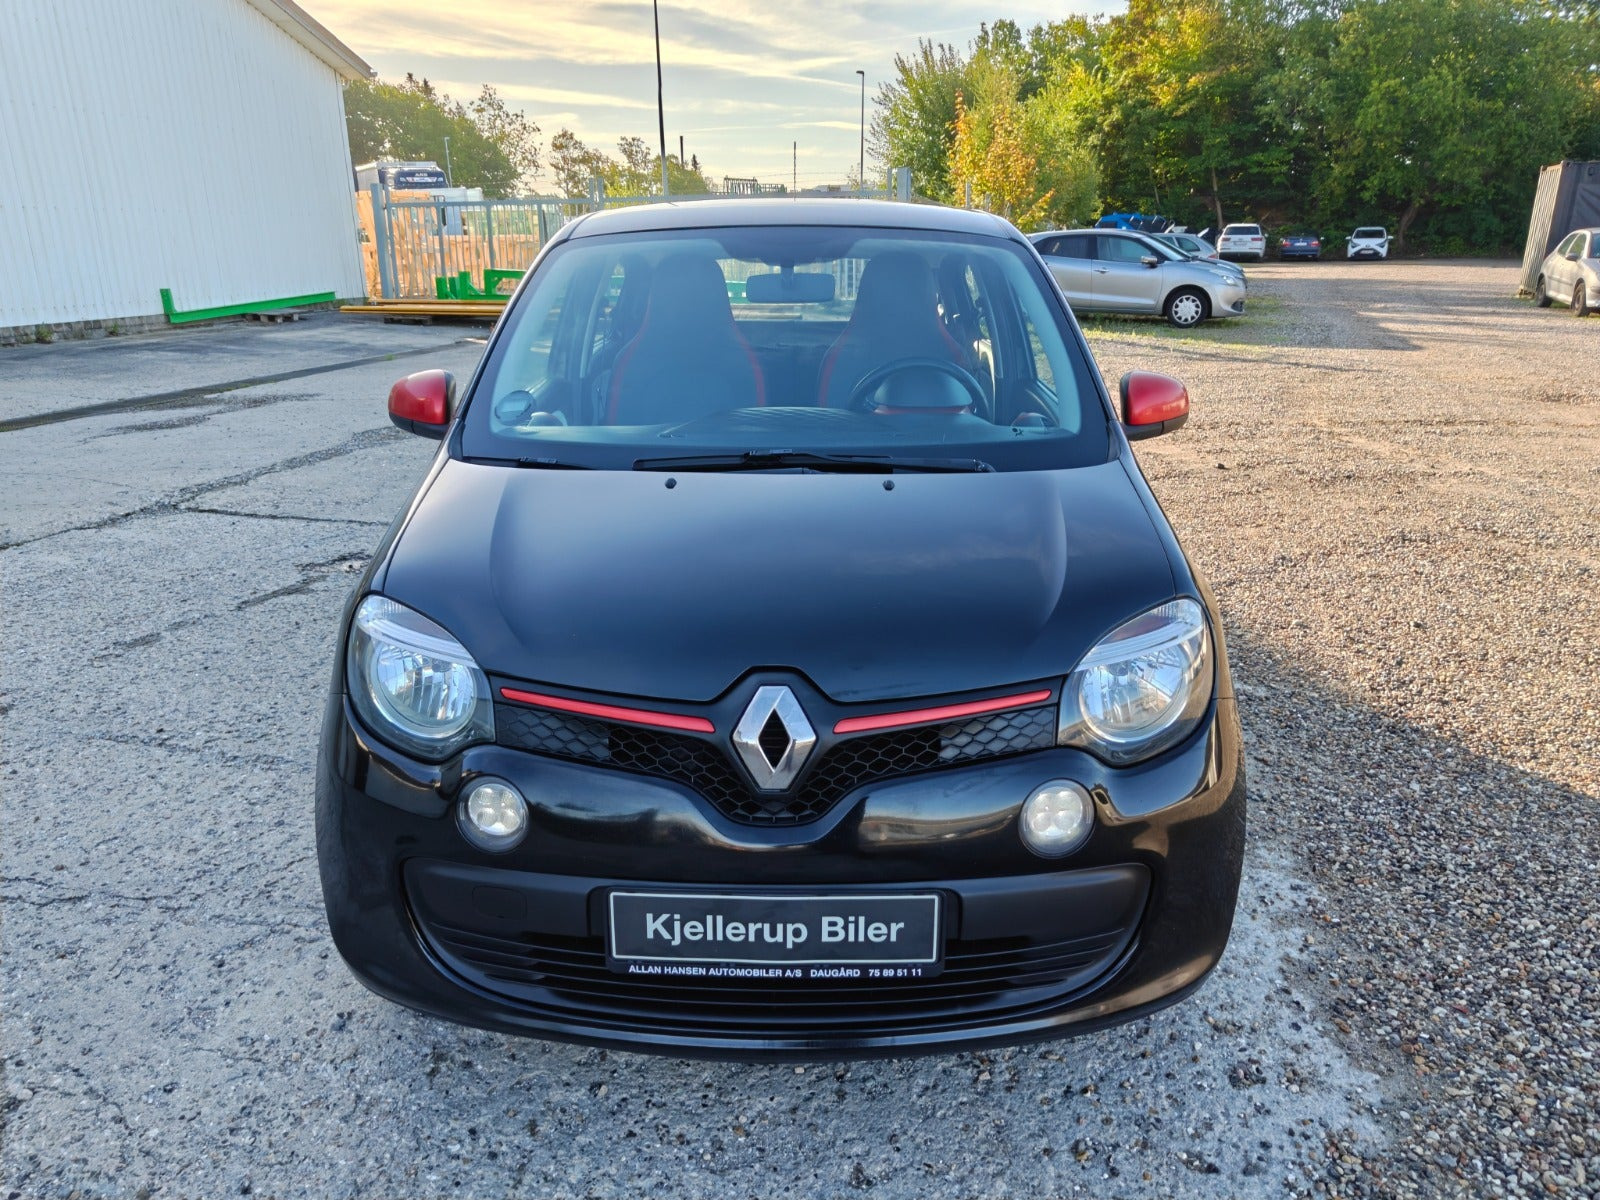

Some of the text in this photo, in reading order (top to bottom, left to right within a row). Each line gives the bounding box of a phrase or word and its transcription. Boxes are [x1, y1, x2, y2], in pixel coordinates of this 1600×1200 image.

[646, 913, 905, 949] Kjellerup Biler
[629, 965, 661, 974] ALLAN
[664, 966, 706, 975] HANSEN
[708, 967, 783, 977] AUTOMOBILER
[785, 968, 802, 978] A/S
[810, 967, 860, 977] DAUGÅRD
[868, 969, 880, 977] 75
[896, 969, 908, 977] 51
[911, 968, 922, 976] 11
